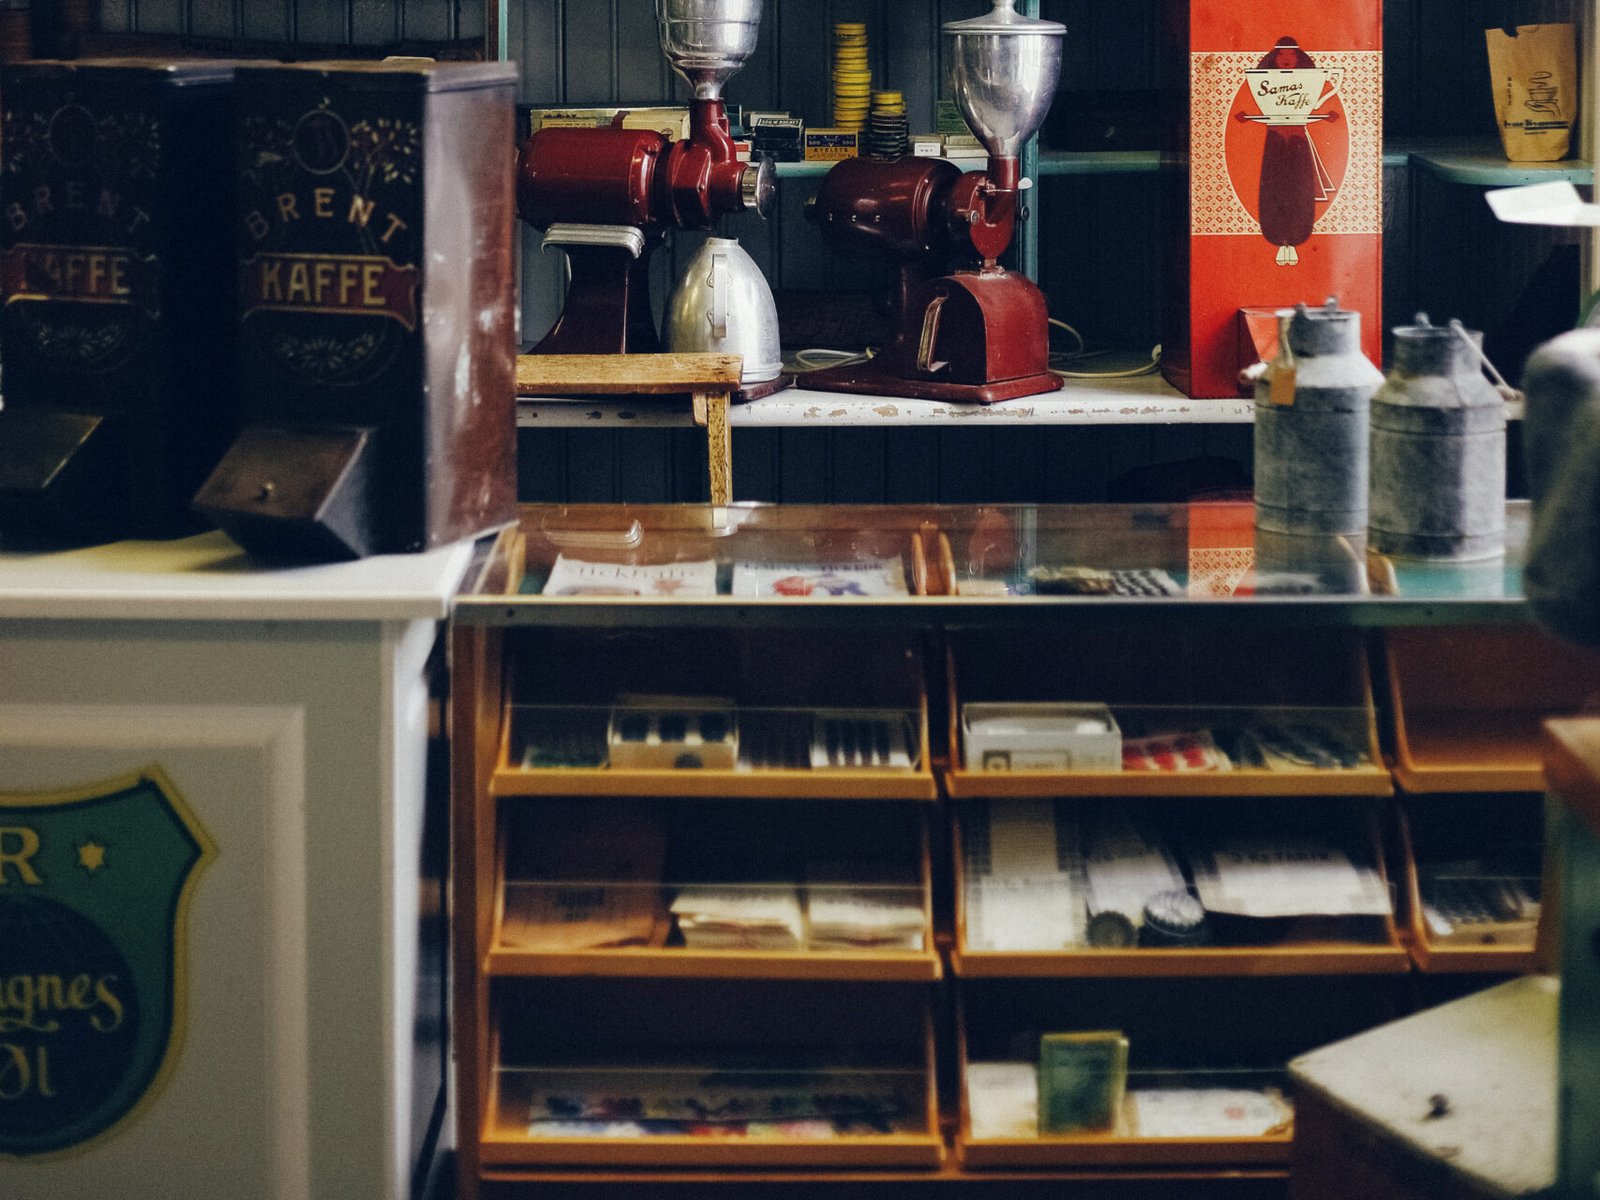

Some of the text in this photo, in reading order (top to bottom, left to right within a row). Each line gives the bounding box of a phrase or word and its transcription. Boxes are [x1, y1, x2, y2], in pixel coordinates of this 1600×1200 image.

[1257, 80, 1303, 97] Samas
[1275, 92, 1310, 110] Kaffe
[245, 187, 407, 243] BRENT
[261, 261, 387, 307] KAFFE
